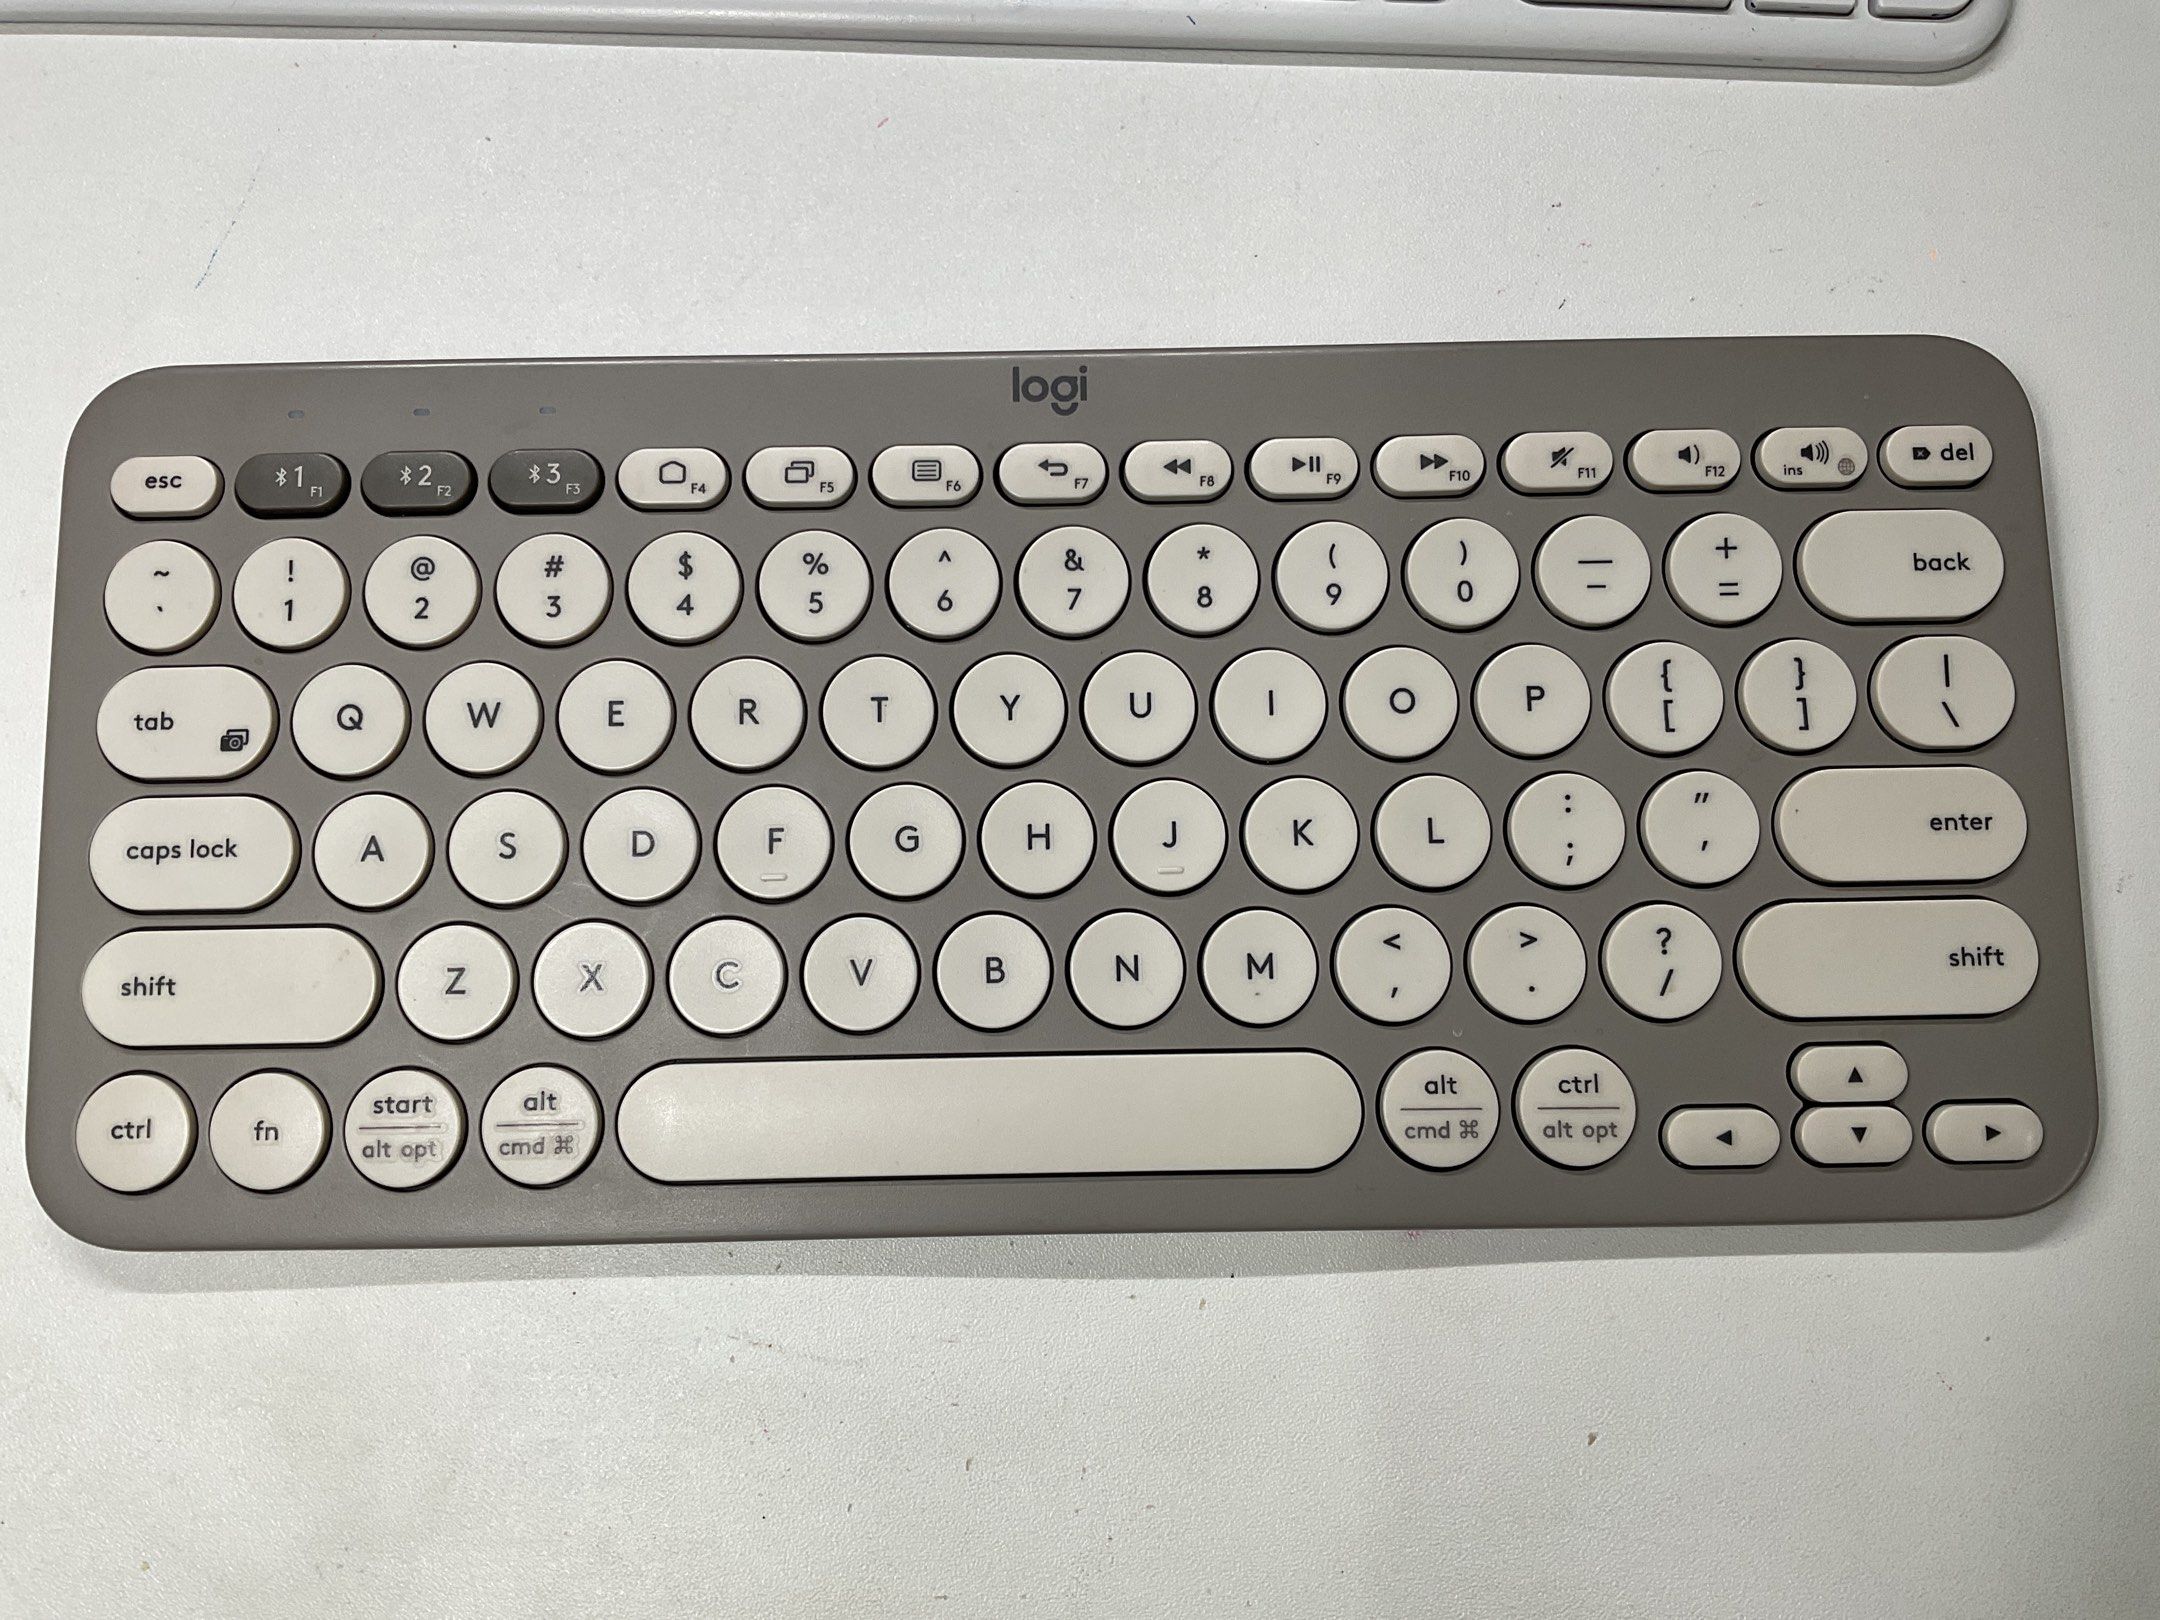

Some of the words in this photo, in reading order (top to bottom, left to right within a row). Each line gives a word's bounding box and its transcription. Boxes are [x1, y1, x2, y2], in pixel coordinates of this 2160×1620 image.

[1012, 365, 1088, 417] logi
[1940, 442, 1975, 461] del
[144, 475, 182, 489] esc
[294, 465, 303, 488] 1
[418, 464, 432, 486] 2
[546, 462, 561, 484] 3
[1199, 475, 1215, 487] F8
[1326, 473, 1342, 485] F9
[1449, 469, 1471, 482] F10
[1577, 467, 1596, 479] F11
[1705, 465, 1725, 477] F12
[1783, 466, 1803, 476] ins
[310, 486, 323, 497] F1
[437, 485, 452, 497] F2
[566, 483, 581, 495] F3
[690, 482, 707, 495] F4
[819, 481, 835, 494] F5
[946, 480, 962, 492] F6
[1074, 477, 1089, 490] F7
[938, 550, 952, 563] ^
[1064, 548, 1085, 572] &
[1328, 543, 1337, 569] (
[1459, 540, 1468, 566] )
[1715, 537, 1738, 560] +
[288, 559, 294, 583] !
[410, 556, 436, 582] @
[544, 554, 565, 578] #
[678, 550, 694, 581] $
[802, 552, 829, 576] %
[1913, 551, 1971, 572] back
[937, 589, 953, 612] 6
[1067, 587, 1082, 611] 7
[1196, 585, 1213, 609] 8
[1325, 582, 1343, 606] 9
[1457, 580, 1474, 603] 0
[1718, 582, 1740, 597] =
[284, 599, 293, 622] 1
[414, 596, 429, 620] 2
[546, 595, 562, 618] 3
[676, 593, 695, 616] 4
[808, 591, 824, 614] 5
[1660, 658, 1673, 693] {
[1793, 656, 1806, 691] }
[870, 696, 889, 723] T
[999, 694, 1021, 721] Y
[1129, 691, 1152, 719] U
[1268, 689, 1274, 716] I
[1389, 687, 1416, 715] O
[1525, 685, 1546, 712] P
[133, 711, 174, 732] tab
[336, 703, 364, 731] Q
[466, 701, 502, 729] W
[608, 700, 625, 727] E
[739, 698, 760, 725] R
[1662, 699, 1676, 733] [
[1796, 697, 1810, 731] ]
[1941, 701, 1960, 728] \
[1564, 794, 1572, 814] :
[1162, 820, 1177, 849] J
[1293, 818, 1314, 847] K
[1427, 817, 1445, 844] L
[1929, 813, 1993, 832] enter
[360, 835, 385, 863] A
[498, 832, 517, 860] S
[631, 830, 656, 858] D
[768, 827, 785, 855] F
[894, 825, 920, 853] G
[1027, 823, 1051, 851] H
[126, 844, 182, 866] caps
[190, 837, 238, 859] lock
[1566, 842, 1574, 867] ;
[1382, 933, 1401, 951] <
[1519, 931, 1538, 949] >
[1655, 927, 1672, 956] ?
[1115, 954, 1140, 982] N
[1246, 952, 1274, 980] M
[1949, 945, 2005, 967] shift
[445, 967, 466, 995] Z
[579, 964, 603, 992] X
[716, 961, 739, 989] C
[849, 958, 873, 987] V
[985, 956, 1006, 984] B
[121, 975, 177, 997] shift
[1659, 968, 1674, 997] /
[1424, 1074, 1458, 1095] alt
[1558, 1072, 1599, 1094] ctrl
[373, 1095, 433, 1115] start
[523, 1090, 557, 1111] alt
[110, 1118, 152, 1140] ctrl
[253, 1119, 279, 1141] fn
[1404, 1120, 1451, 1139] cmd
[1542, 1119, 1573, 1139] alt
[1582, 1122, 1618, 1144] opt
[362, 1139, 391, 1159] alt
[401, 1141, 437, 1162] opt
[499, 1136, 545, 1156] cmd
